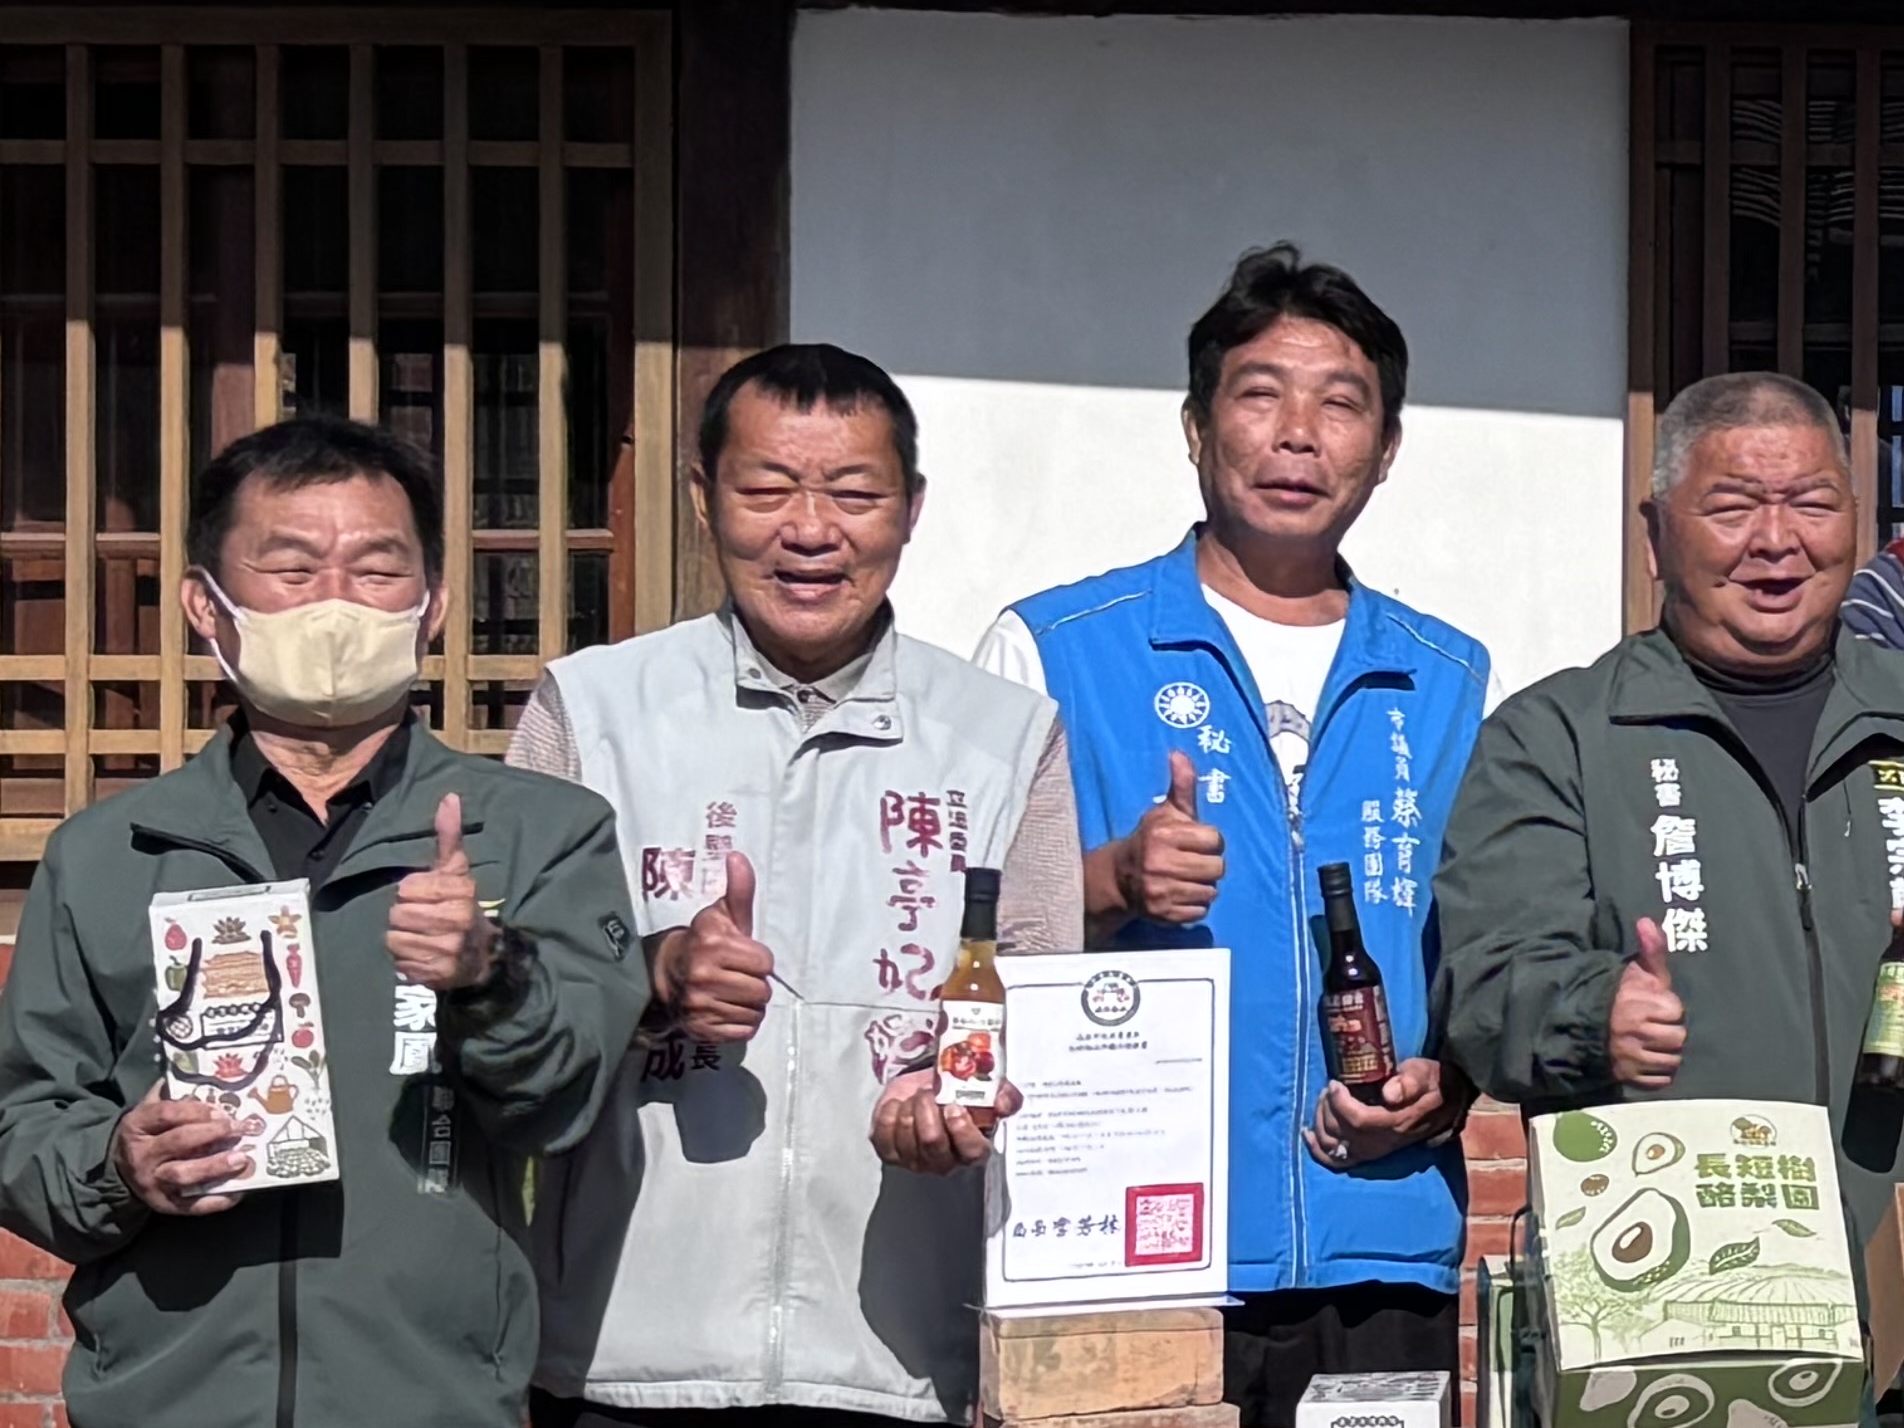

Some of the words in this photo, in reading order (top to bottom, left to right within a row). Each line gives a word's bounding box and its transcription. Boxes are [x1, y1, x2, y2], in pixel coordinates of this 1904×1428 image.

[1197, 724, 1232, 803] 秘書
[1695, 1153, 1818, 1183] 長短樹
[1695, 1181, 1820, 1211] 酪梨園
